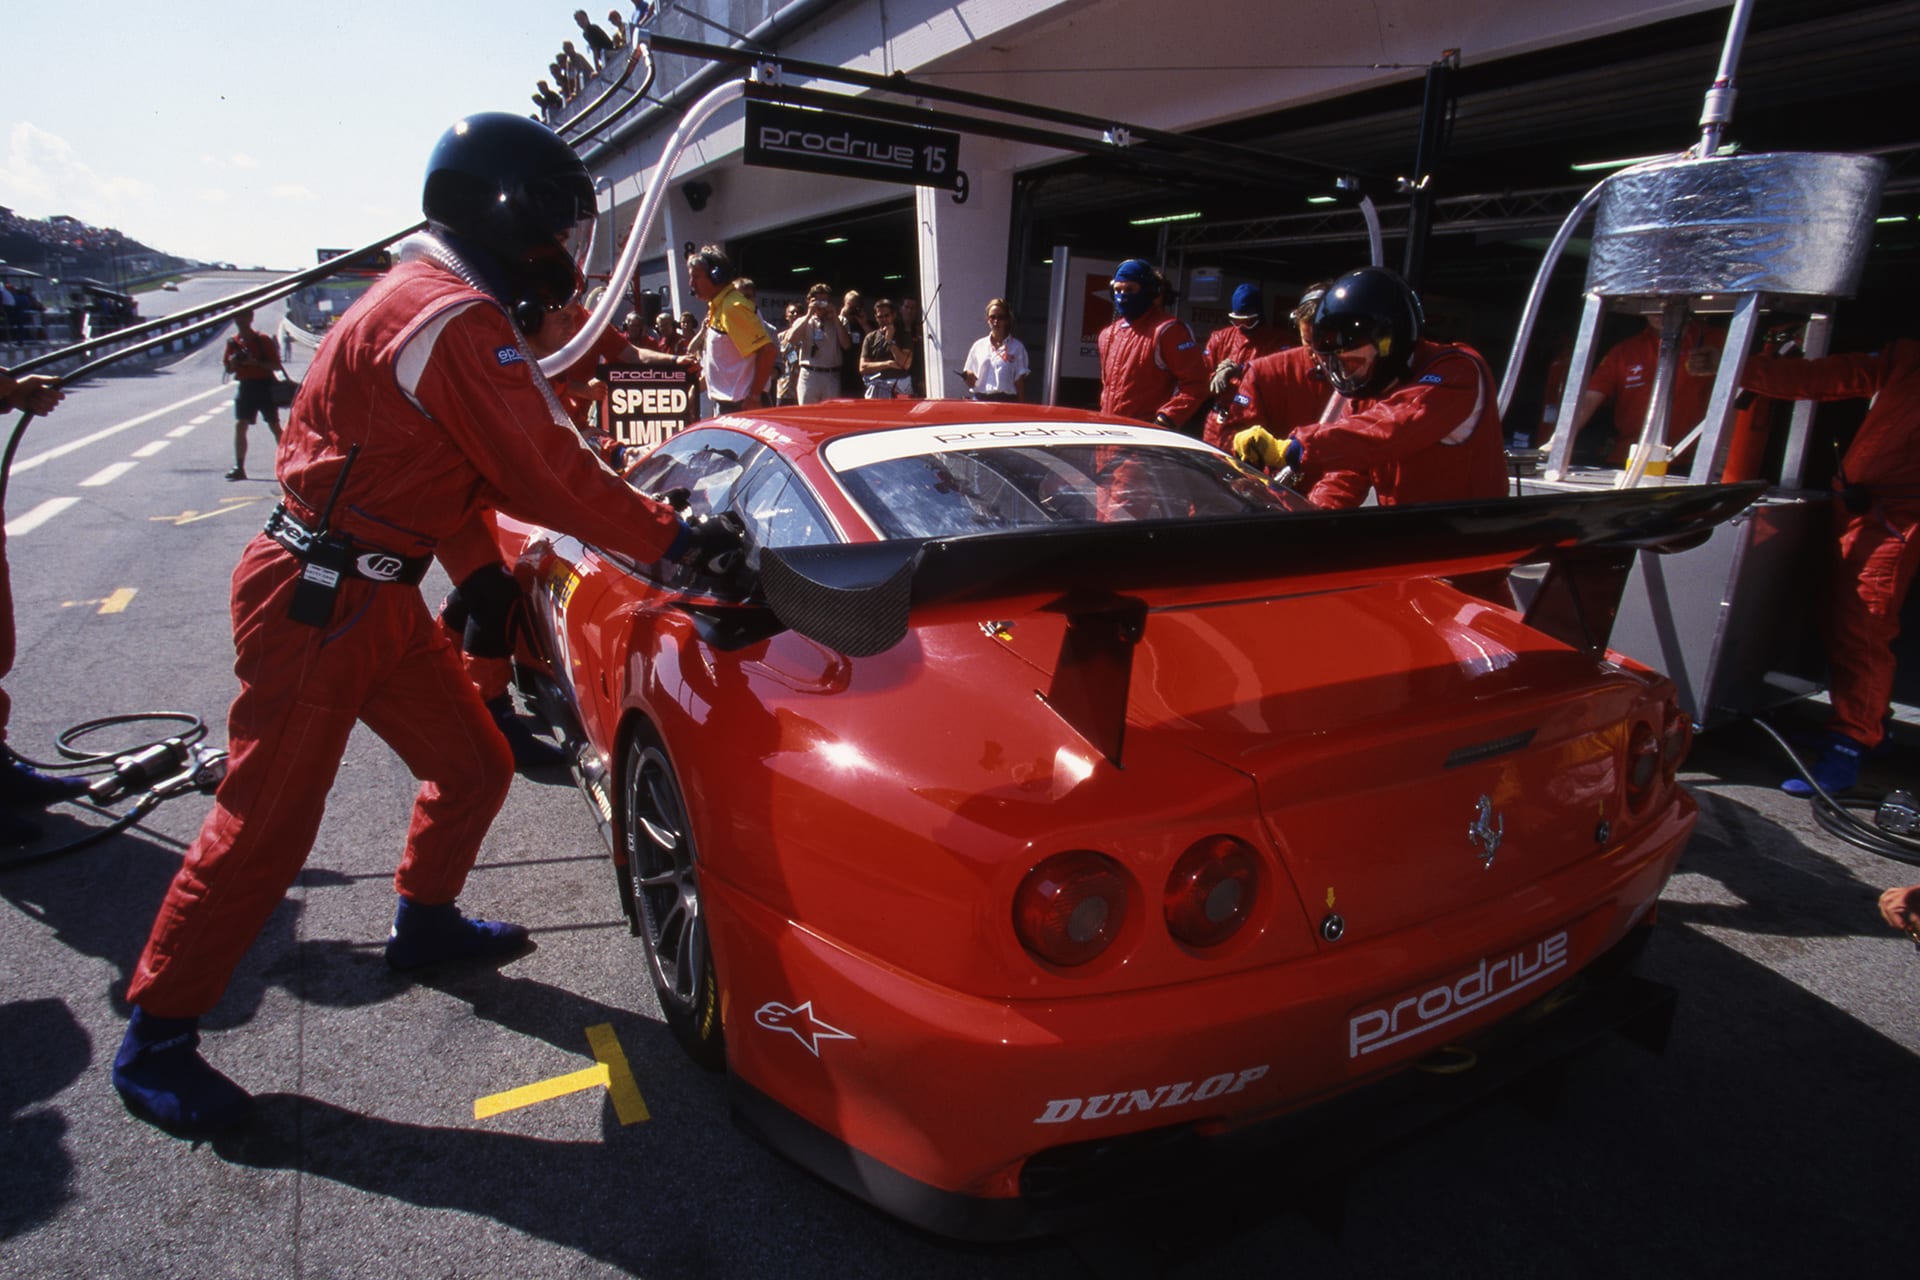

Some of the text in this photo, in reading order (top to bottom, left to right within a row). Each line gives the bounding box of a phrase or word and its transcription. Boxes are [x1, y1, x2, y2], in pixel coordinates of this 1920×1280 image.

[760, 127, 947, 174] prodrive 15
[951, 169, 969, 204] 9
[609, 369, 687, 382] prodrive
[611, 388, 687, 414] SPEED
[934, 428, 1136, 444] prodrive
[1349, 931, 1568, 1058] prodrive
[1033, 1065, 1270, 1123] DUNLOP
